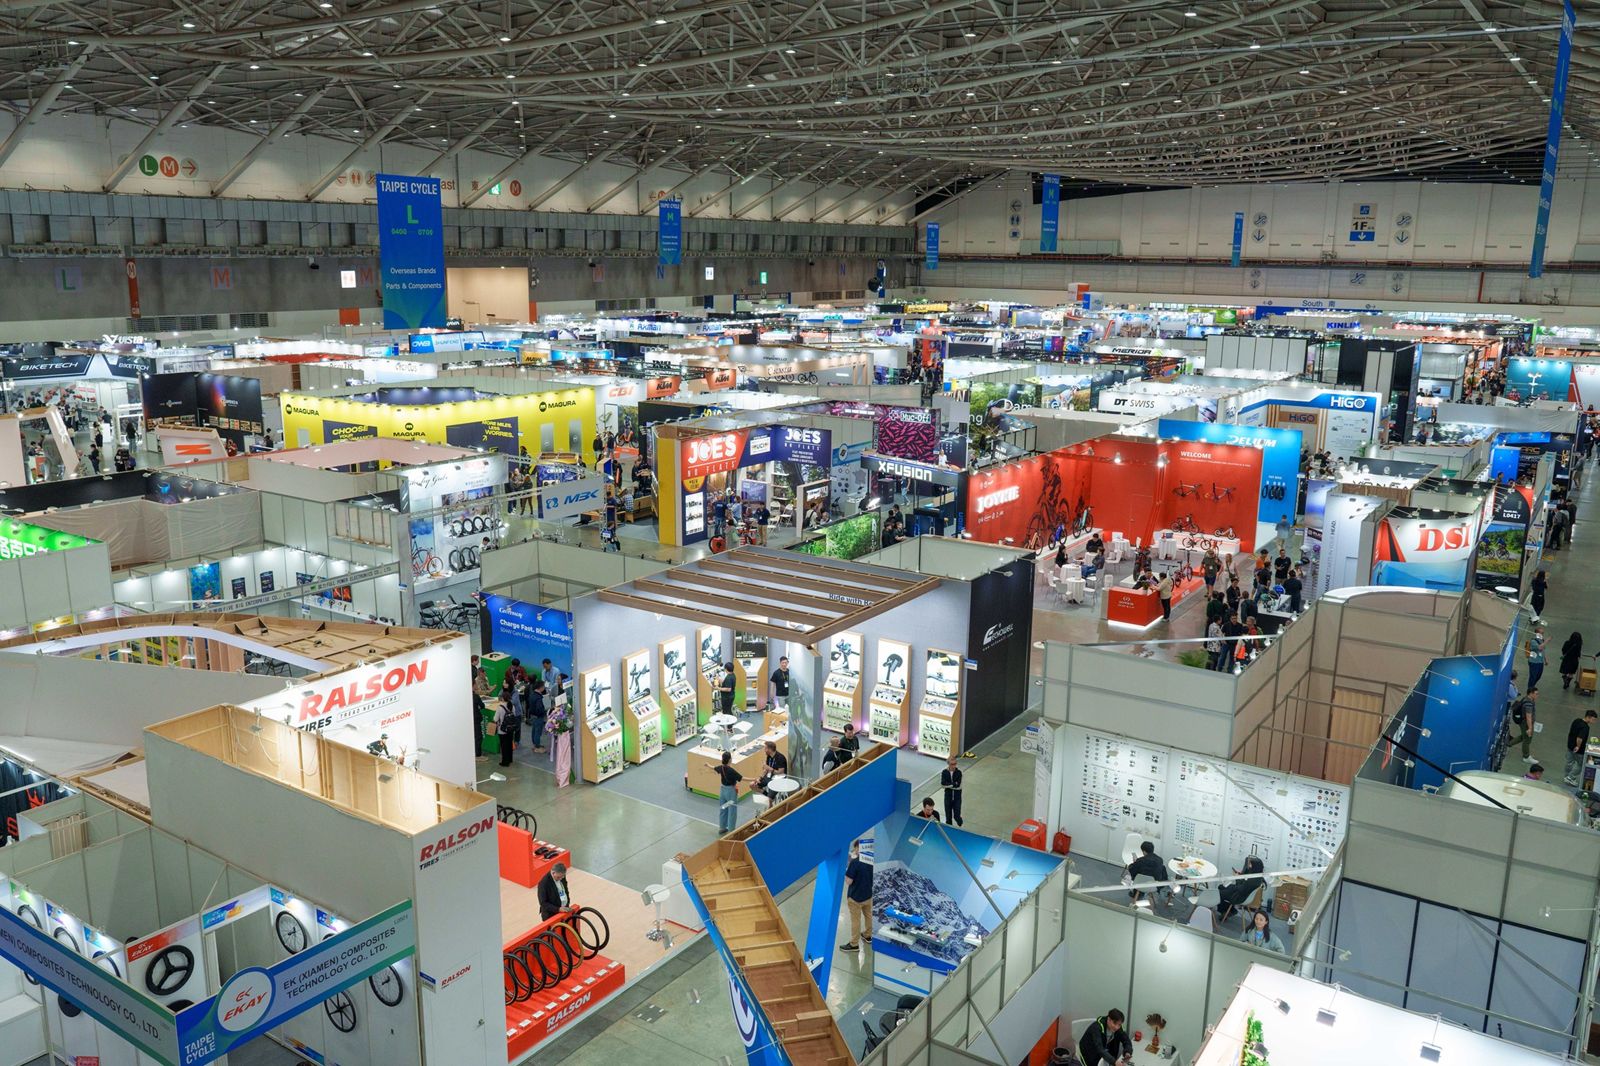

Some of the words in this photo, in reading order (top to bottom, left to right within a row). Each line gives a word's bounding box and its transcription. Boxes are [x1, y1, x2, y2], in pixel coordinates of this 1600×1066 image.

[144, 158, 154, 173] L
[163, 160, 176, 174] M
[380, 180, 408, 194] TAIPEI
[410, 182, 438, 195] CYCLE
[440, 180, 456, 190] ast
[406, 204, 419, 224] L
[1352, 222, 1368, 230] 1F
[62, 268, 76, 290] L
[213, 268, 230, 288] M
[386, 282, 400, 290] Parts
[408, 282, 442, 290] Components
[959, 336, 990, 344] GIANT
[20, 362, 78, 371] BIKETECH
[118, 362, 150, 371] BIKETECH
[715, 374, 730, 383] KTM
[548, 400, 576, 410] MAGURA
[1114, 398, 1128, 406] DT
[1130, 400, 1155, 408] SWISS
[294, 406, 320, 416] MAGURA
[969, 412, 983, 425] ng
[332, 426, 368, 436] CHOOSE
[1180, 451, 1212, 459] WELCOME
[706, 460, 736, 473] FLATS
[564, 488, 600, 504] MBK
[829, 593, 846, 602] Ride
[846, 596, 862, 606] with
[500, 619, 520, 630] Charge
[521, 624, 535, 633] Fast.
[536, 628, 549, 636] Ride
[298, 659, 428, 722] RALSON
[380, 710, 412, 727] RALSON
[420, 816, 495, 862] RALSON
[419, 856, 440, 870] TIRES
[283, 978, 296, 990] EK
[299, 956, 339, 981] (XIAMEN)
[340, 926, 396, 960] COMPOSITES
[286, 962, 348, 999] TECHNOLOGY
[350, 954, 368, 966] CO.,
[370, 943, 388, 956] LTD.
[441, 965, 471, 986] RALSON
[16, 940, 65, 978] COMPOSITES
[66, 970, 122, 1014] TECHNOLOGY
[123, 1008, 141, 1030] CO.,
[142, 1020, 161, 1041] LTD.
[224, 992, 268, 1022] EKAY
[546, 991, 592, 1028] RALSON
[185, 1032, 215, 1054] TAIPEI
[185, 1042, 216, 1065] CYCLE
